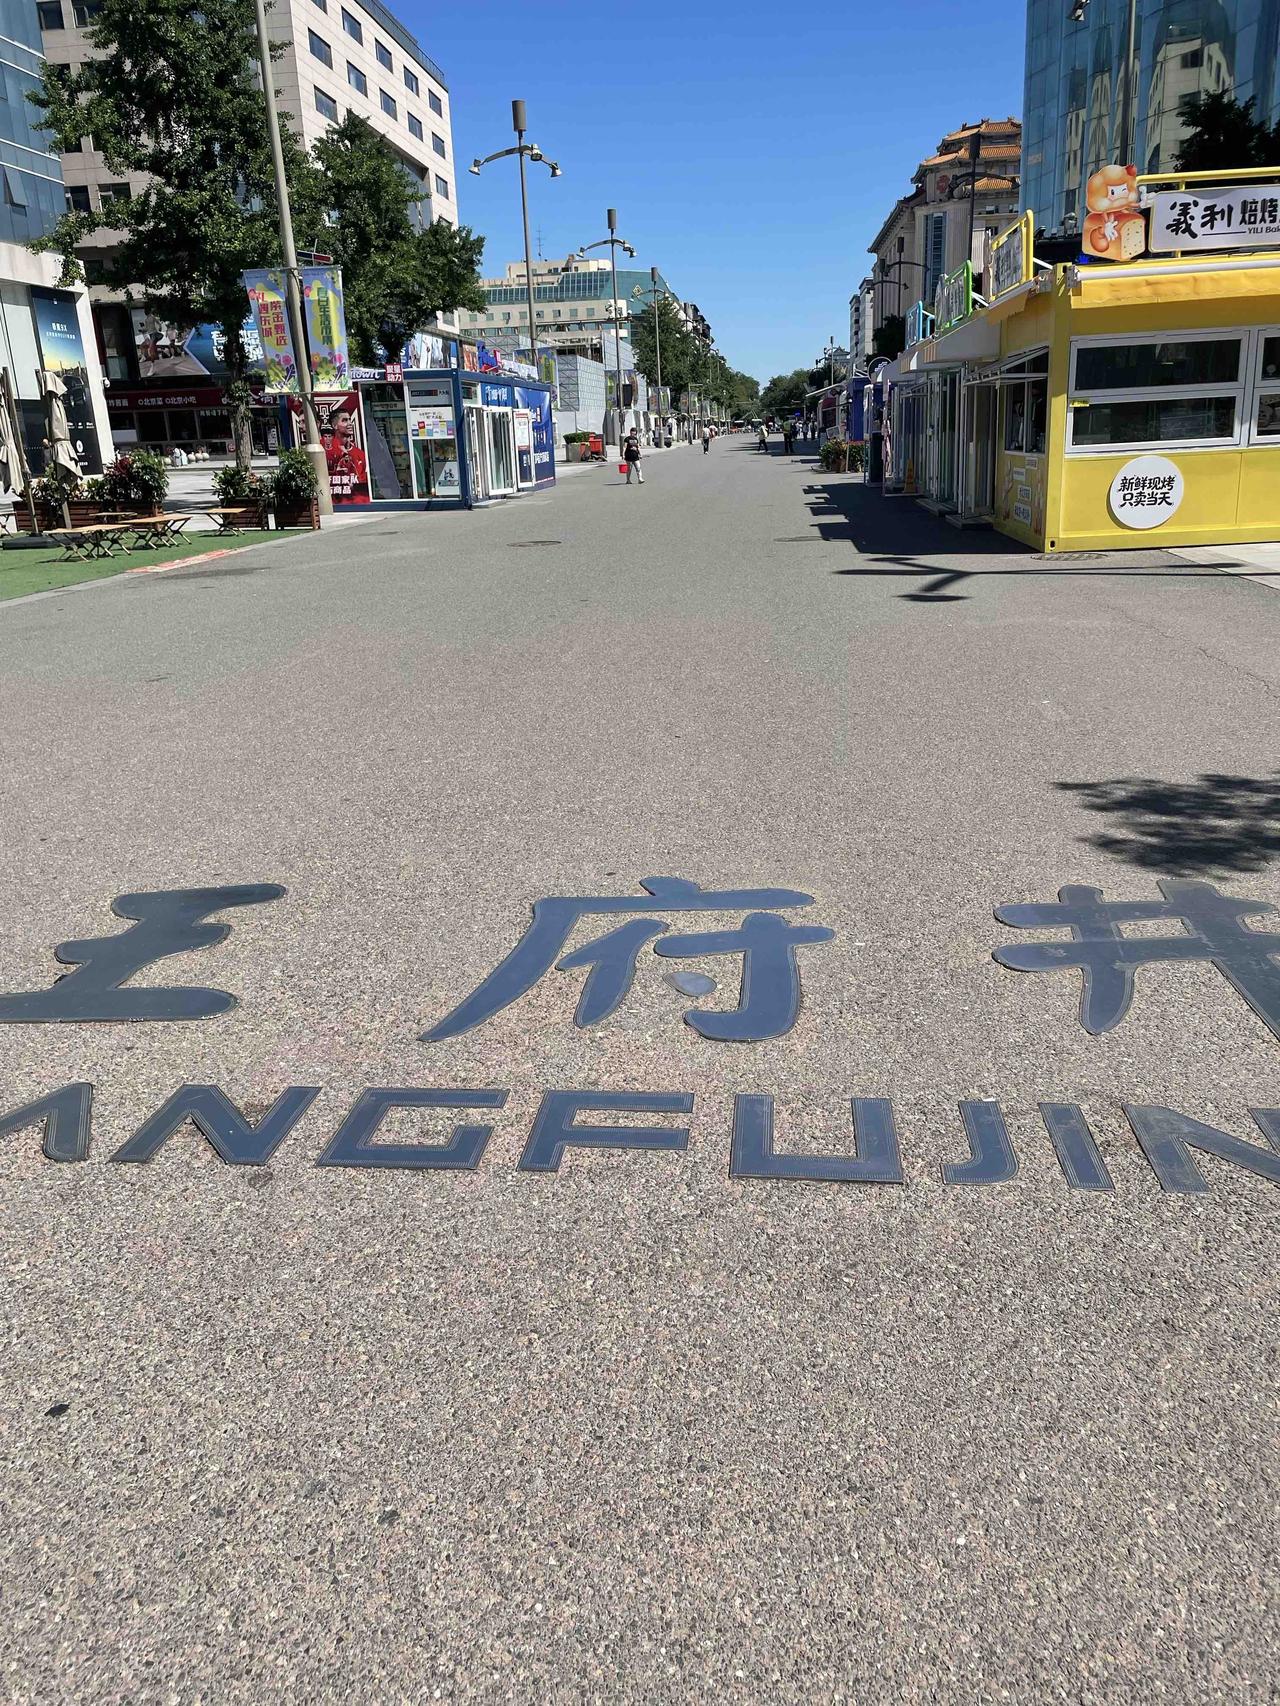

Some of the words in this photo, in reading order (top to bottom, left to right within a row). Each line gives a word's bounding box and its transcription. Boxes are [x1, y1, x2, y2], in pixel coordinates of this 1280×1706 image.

[1165, 199, 1234, 239] 義利
[1239, 197, 1278, 226] 焙烤
[1118, 476, 1176, 492] 新鲜现烤
[1119, 491, 1173, 507] 只卖当天
